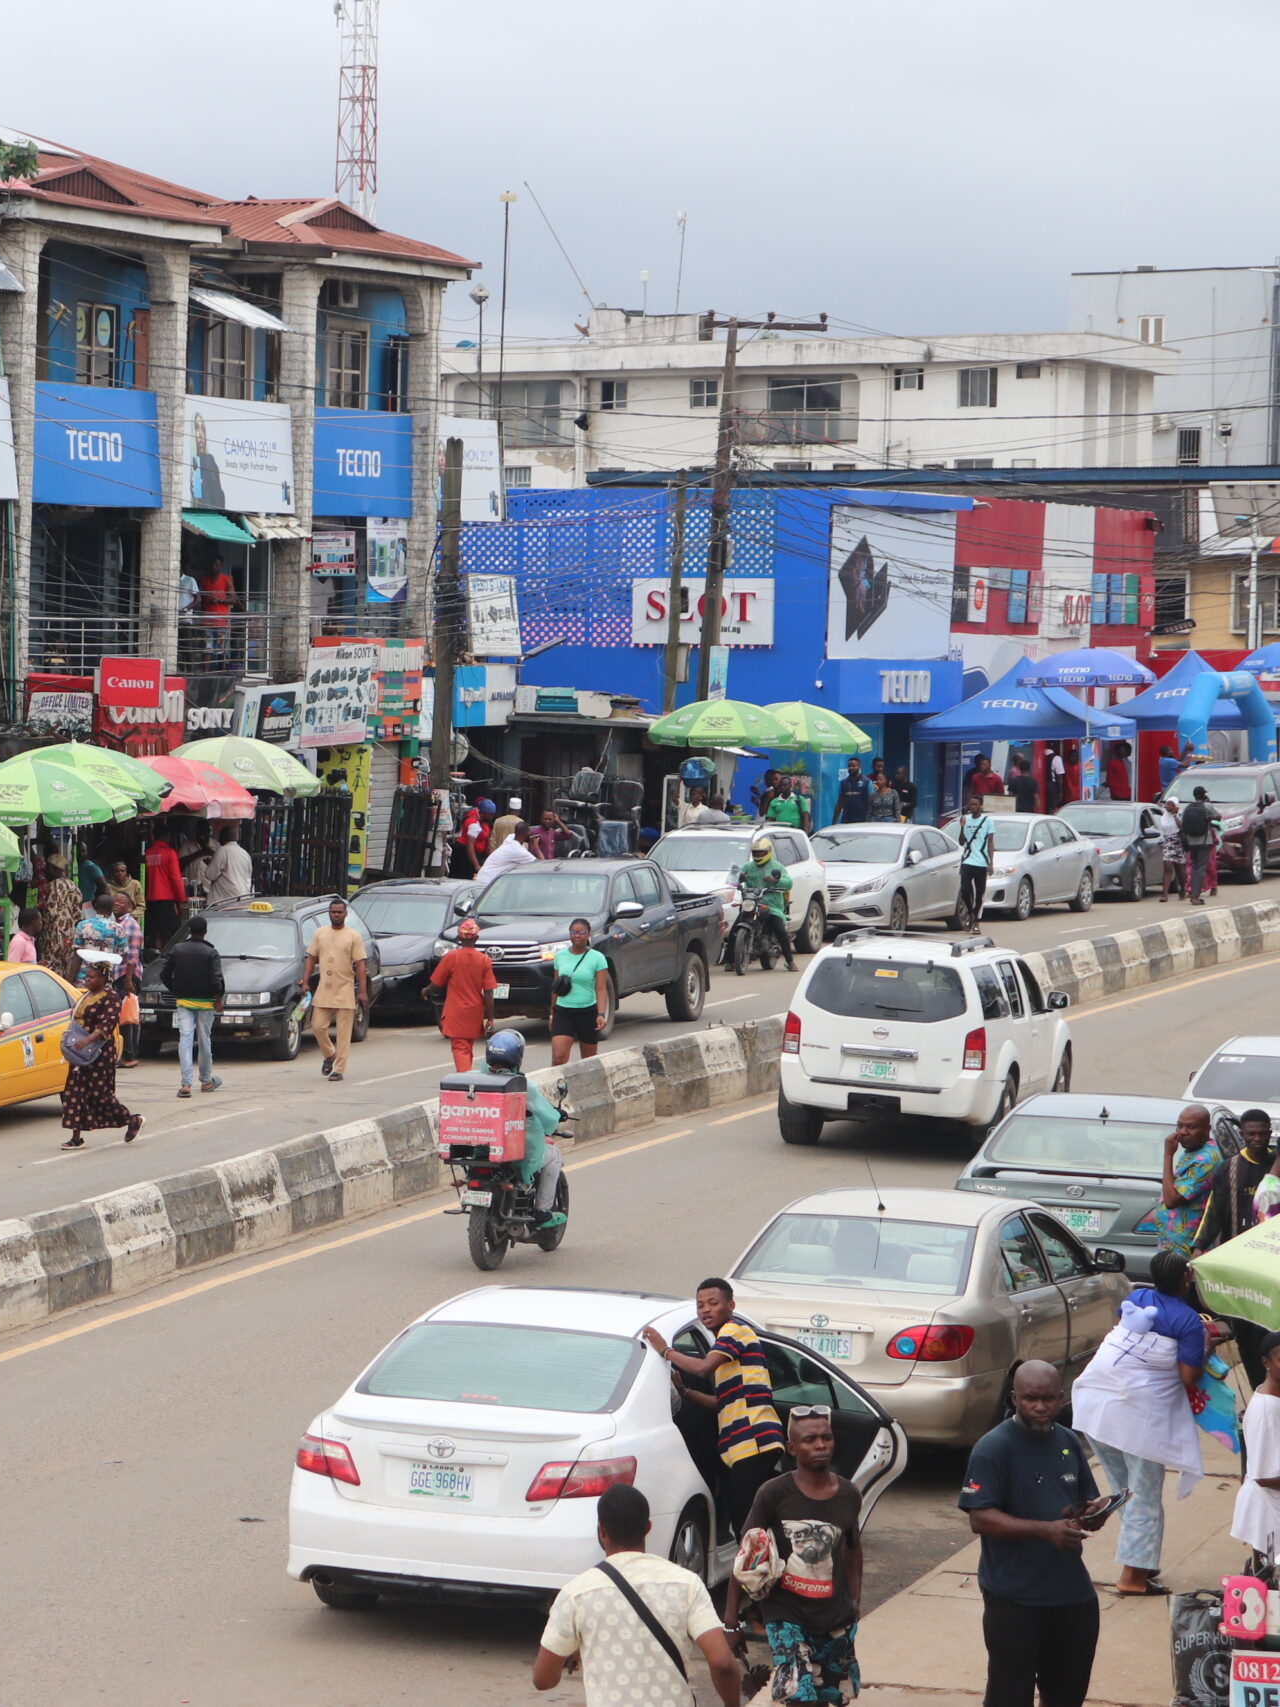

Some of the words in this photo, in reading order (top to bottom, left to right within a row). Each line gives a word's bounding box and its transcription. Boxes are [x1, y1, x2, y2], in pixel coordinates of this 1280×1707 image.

[66, 429, 123, 462] TECNO
[224, 437, 257, 457] CAMON
[336, 448, 381, 478] TECNO
[335, 648, 353, 660] Nikon
[353, 646, 371, 659] SONY
[1058, 666, 1091, 674] TECNO
[106, 676, 154, 689] Canon
[879, 670, 931, 703] TECNO
[41, 693, 63, 708] OFFICE
[64, 693, 89, 708] LIMITED
[1154, 687, 1191, 699] TEC
[981, 699, 1038, 711] TECNO
[187, 708, 234, 730] SONY
[249, 902, 270, 911] TAXI
[440, 1105, 500, 1120] gamma
[443, 1134, 477, 1142] COMMUNITY
[1203, 1279, 1220, 1292] The
[784, 1575, 830, 1592] Supreme
[1174, 1631, 1211, 1655] SUPER
